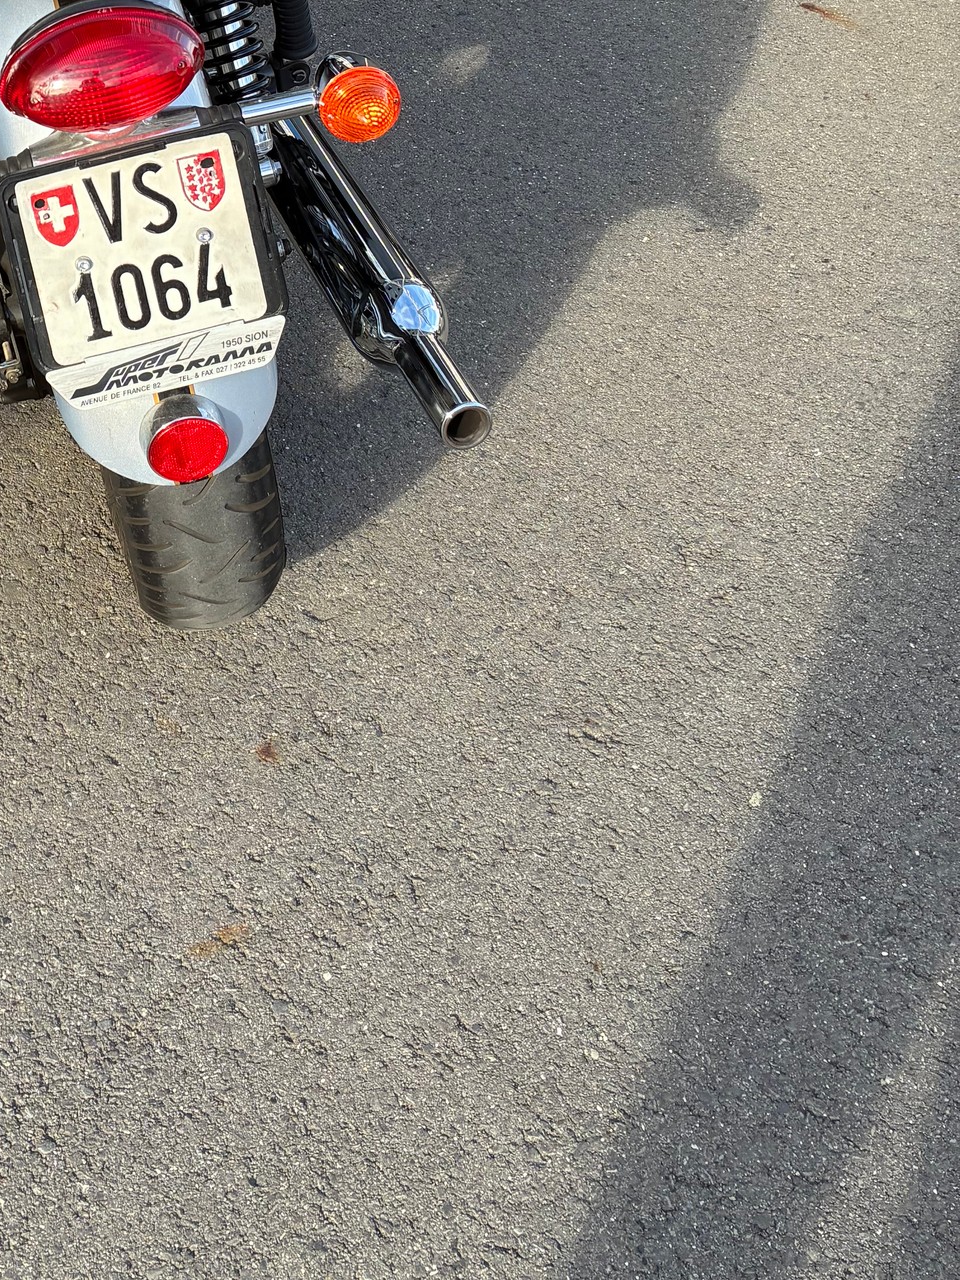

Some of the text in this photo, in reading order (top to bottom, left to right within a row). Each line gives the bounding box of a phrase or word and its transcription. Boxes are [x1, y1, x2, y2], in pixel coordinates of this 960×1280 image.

[81, 162, 178, 244] VS
[73, 243, 233, 342] 1064
[221, 330, 269, 349] 1950 SION
[179, 375, 193, 383] TEL.
[201, 369, 214, 377] FAX
[215, 365, 228, 374] 027
[233, 360, 246, 370] 322
[247, 357, 256, 366] 45
[257, 355, 266, 363] 55
[80, 394, 108, 407] AVENUE
[110, 391, 121, 400] DE
[122, 385, 151, 397] FRANCE
